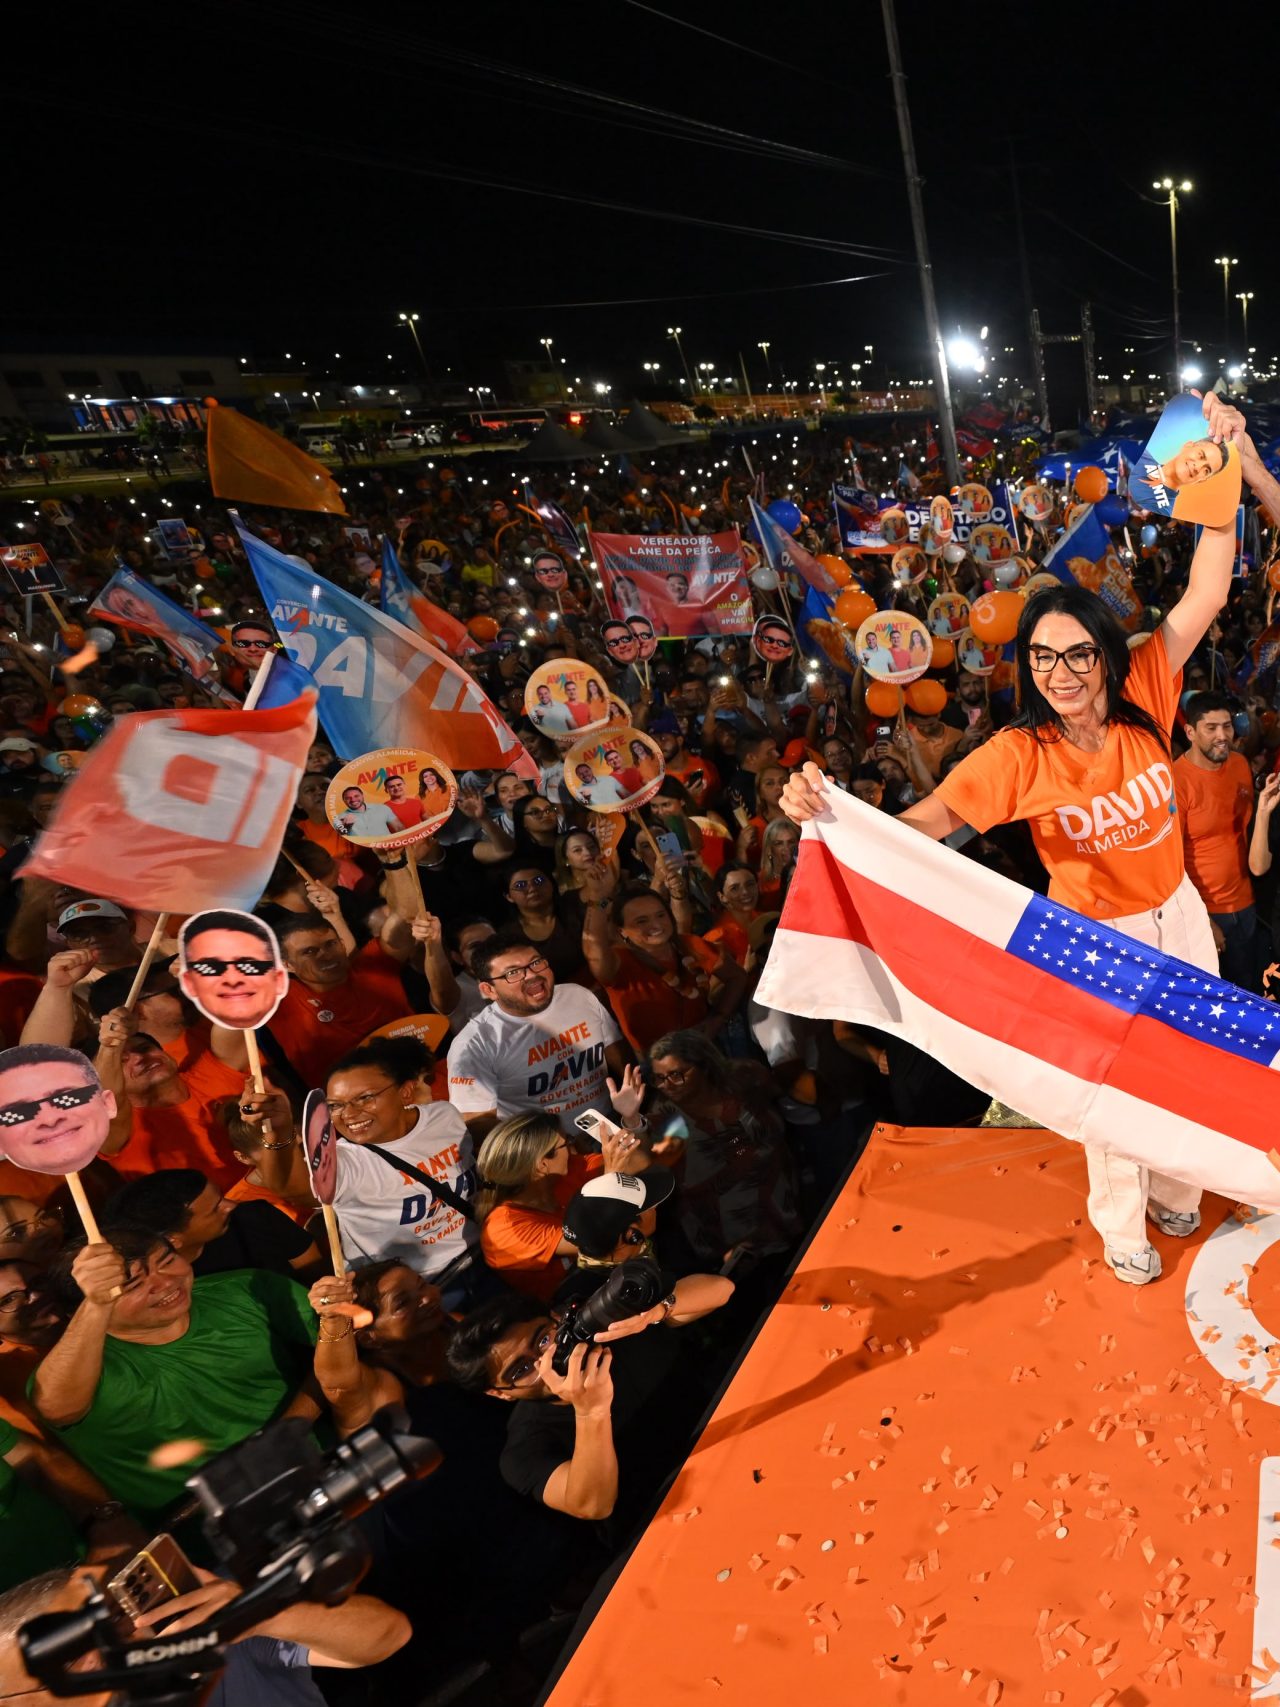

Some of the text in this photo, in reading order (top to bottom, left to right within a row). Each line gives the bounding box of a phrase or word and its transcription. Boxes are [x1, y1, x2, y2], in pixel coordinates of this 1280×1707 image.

[1144, 464, 1170, 509] AVANTE
[907, 506, 1007, 525] DETADO
[629, 546, 722, 556] LANE DA PESCA
[640, 536, 713, 546] VEREADORA
[271, 604, 348, 634] AVANTE
[582, 735, 627, 762] AVANTE
[357, 760, 418, 787] AVANTE
[1055, 762, 1174, 841] DAVID
[1076, 819, 1150, 855] ALMEIDA
[527, 1021, 592, 1067] AVANTE
[557, 1048, 575, 1062] COM
[528, 1042, 605, 1097] DAVID
[127, 1631, 219, 1667] RONIN
